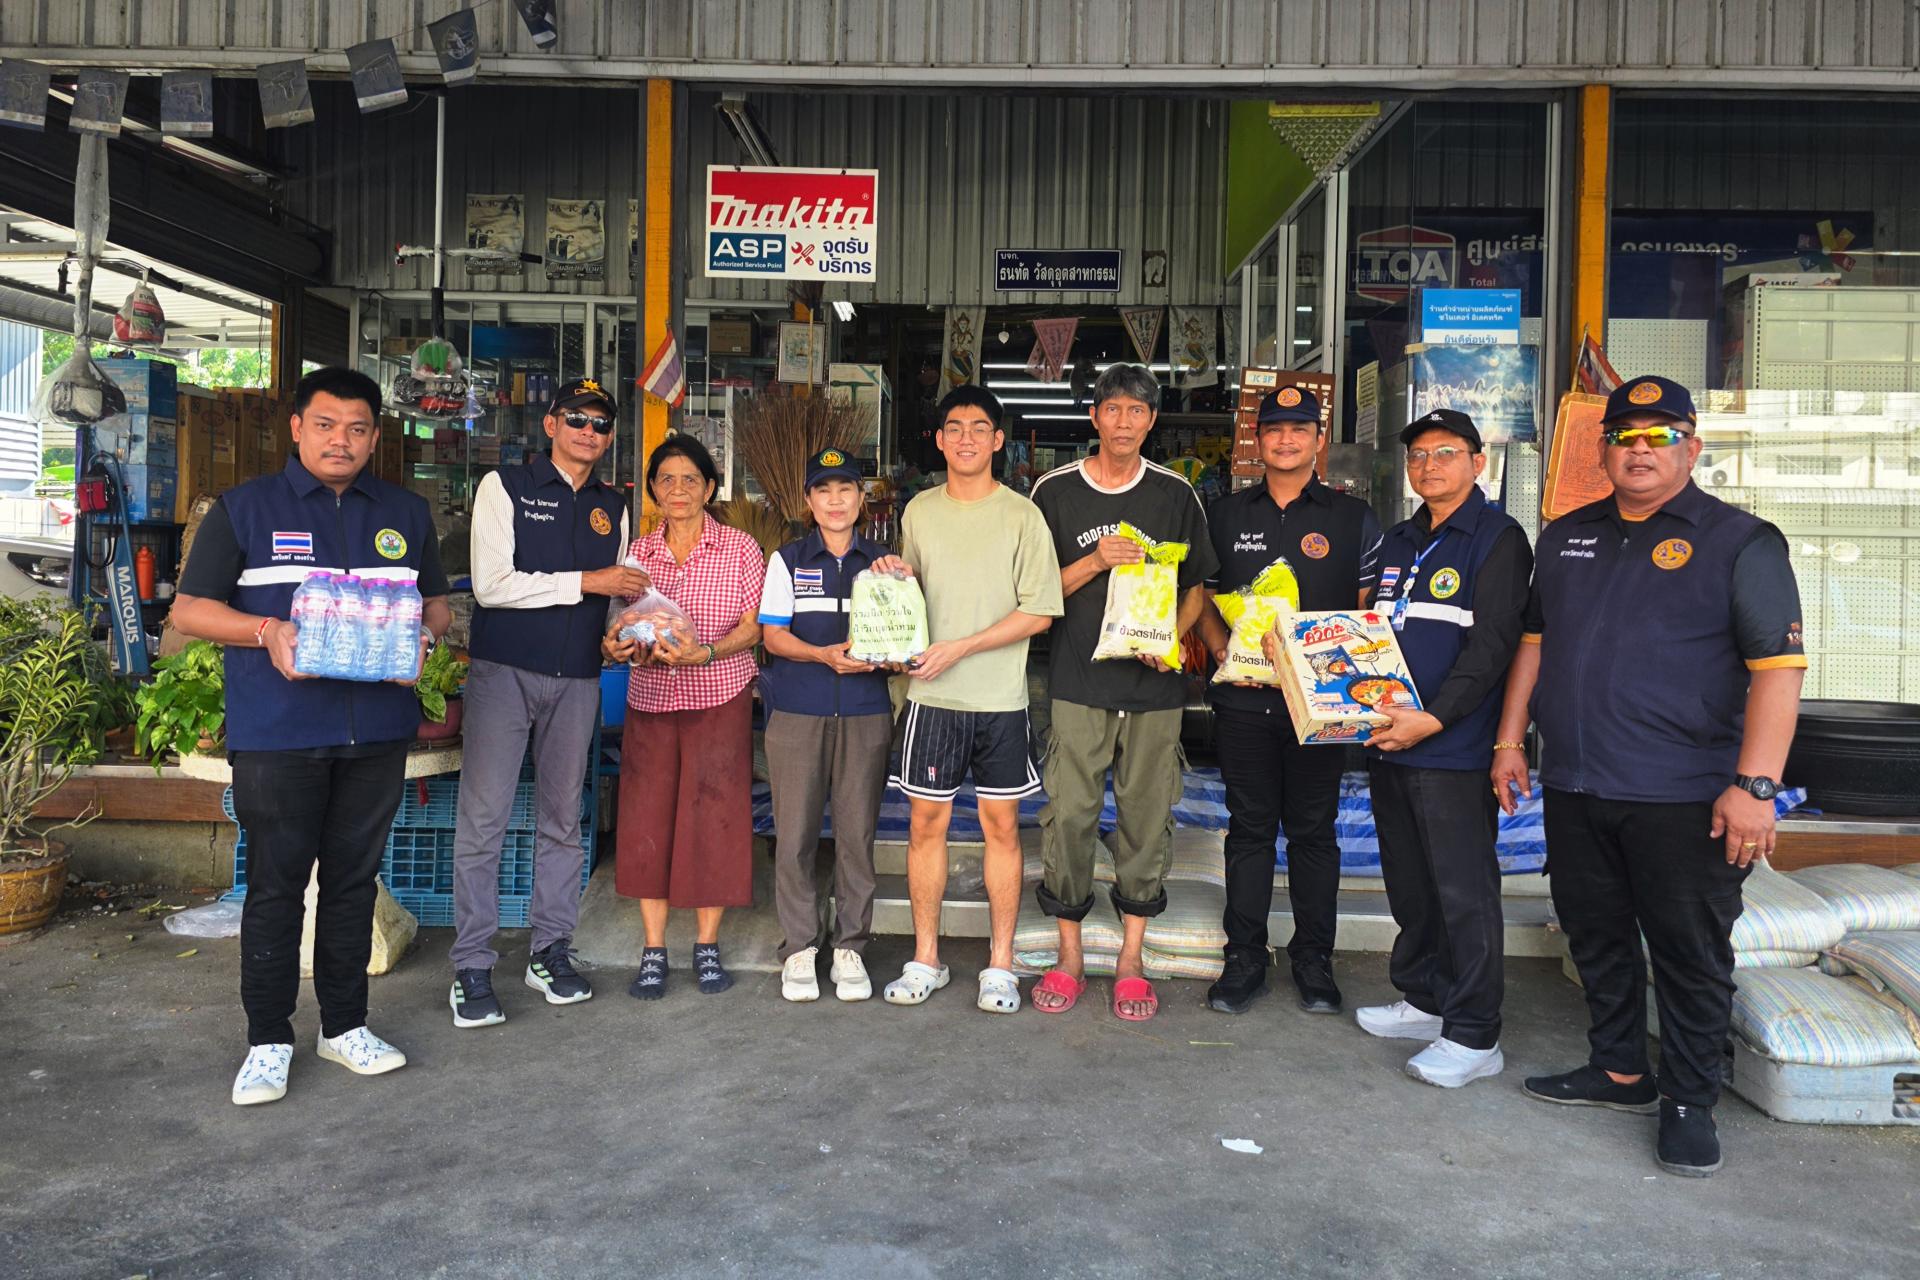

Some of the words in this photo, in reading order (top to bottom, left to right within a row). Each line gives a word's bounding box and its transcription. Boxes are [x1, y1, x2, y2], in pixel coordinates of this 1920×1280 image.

[468, 200, 498, 208] JAIC
[549, 203, 578, 212] JAIC
[713, 238, 783, 258] ASP
[822, 237, 869, 257] จุดรับ
[713, 260, 744, 268] Authorized
[1000, 252, 1019, 260] บจก.
[818, 258, 872, 275] บริการ
[1363, 250, 1448, 281] TOA
[1000, 262, 1029, 281] ธนทัต
[1034, 262, 1117, 288] วัสดุอุตสาหกรรม
[1469, 277, 1497, 287] Total
[118, 566, 139, 644] MARQUIS
[1119, 625, 1172, 641] ข้าวตราไก่แจ้
